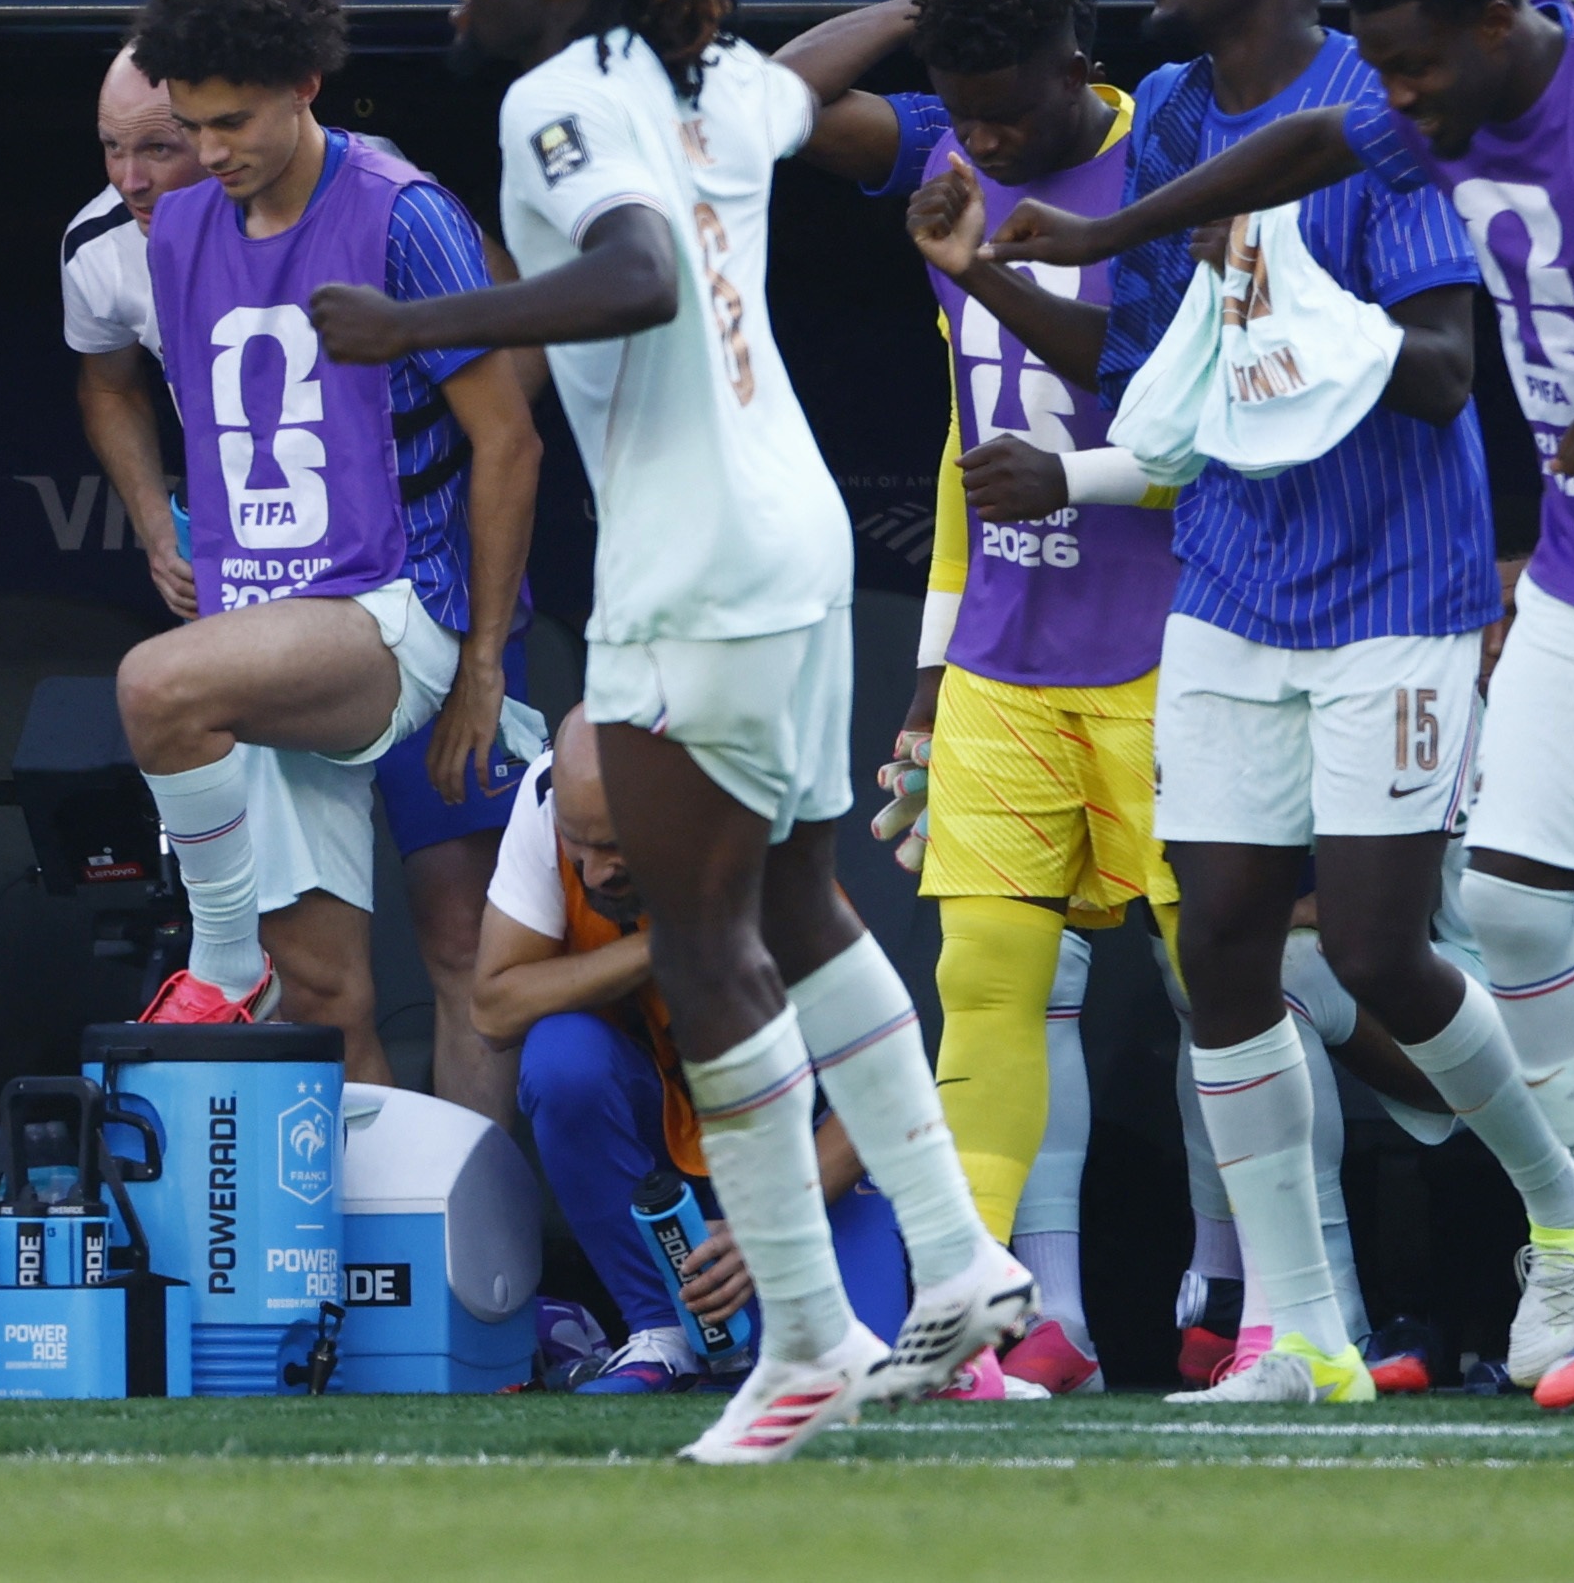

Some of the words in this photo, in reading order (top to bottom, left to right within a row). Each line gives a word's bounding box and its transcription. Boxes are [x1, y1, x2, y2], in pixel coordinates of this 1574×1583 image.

[239, 502, 297, 527] FIFA
[982, 525, 1078, 569] 2026
[220, 557, 282, 582] WORLD
[1393, 688, 1439, 771] 15
[86, 867, 137, 879] Lenovo
[289, 1171, 328, 1181] FRANCE
[209, 1095, 237, 1294] POWERADE
[267, 1249, 337, 1272] POWER
[307, 1274, 337, 1296] ADE
[5, 1323, 68, 1342] POWER
[32, 1343, 68, 1360] ADE
